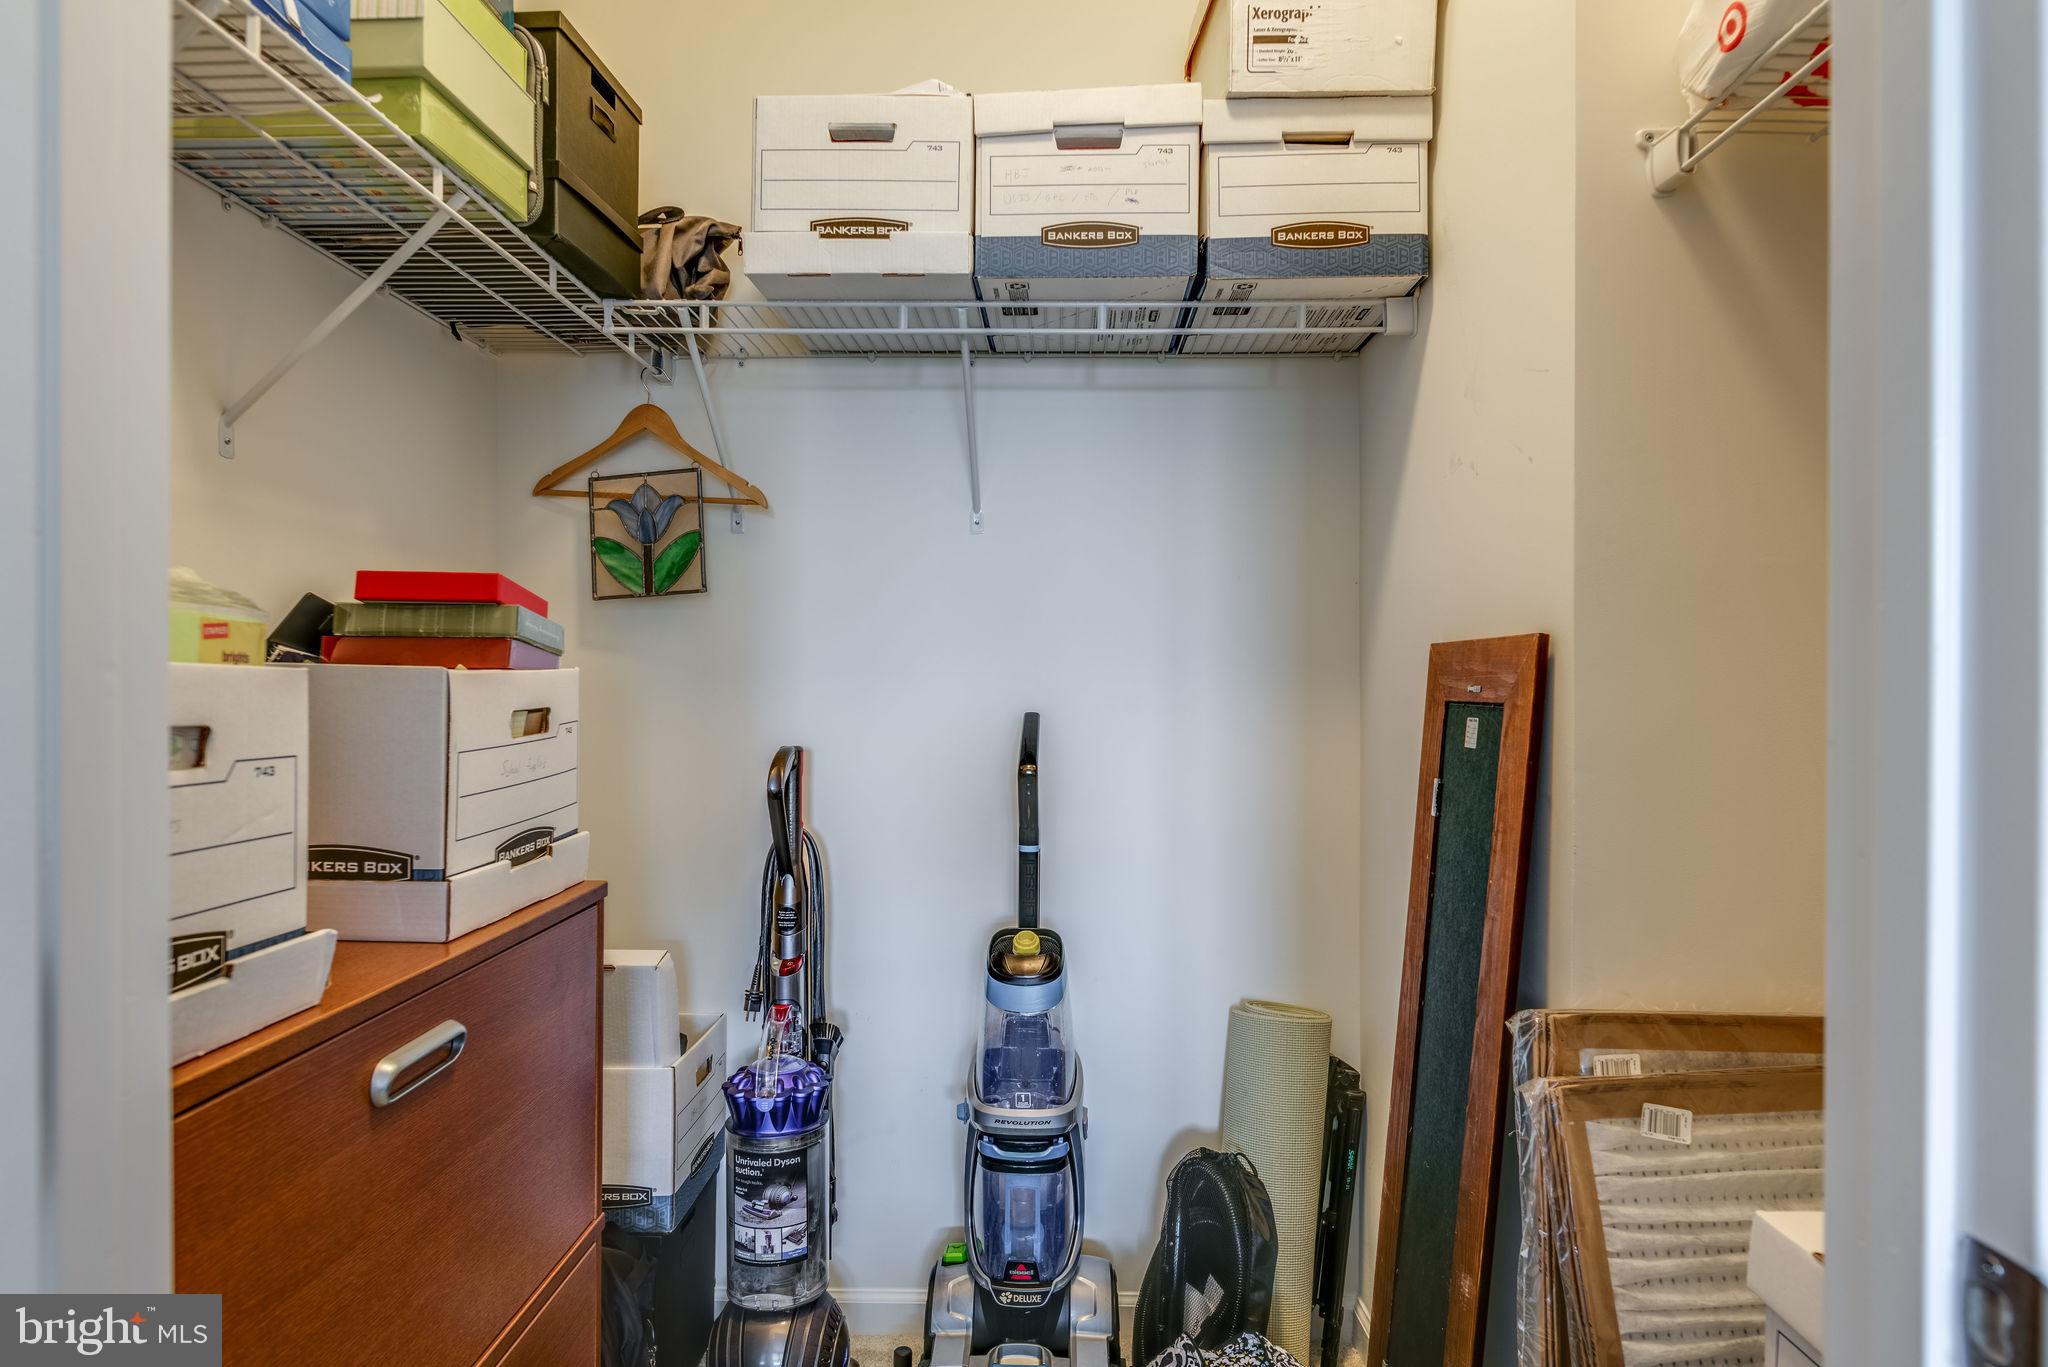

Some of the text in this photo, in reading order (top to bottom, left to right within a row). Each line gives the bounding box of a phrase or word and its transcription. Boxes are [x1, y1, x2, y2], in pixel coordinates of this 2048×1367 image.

[926, 144, 943, 152] 743
[1157, 147, 1174, 155] 743
[1386, 146, 1403, 154] 743
[816, 225, 875, 236] BANKERS
[1047, 230, 1133, 241] BANKERS BOX
[1277, 230, 1363, 241] BANKERS BOX
[254, 765, 276, 778] 743
[498, 835, 552, 862] BANKERS BOX
[307, 861, 403, 874] KERS BOX
[176, 944, 221, 974] BOX
[1020, 1094, 1026, 1102] 1
[735, 1154, 801, 1168] Unrivaled Dyson
[621, 1192, 649, 1201] BOX
[1013, 1294, 1042, 1303] DELUXE
